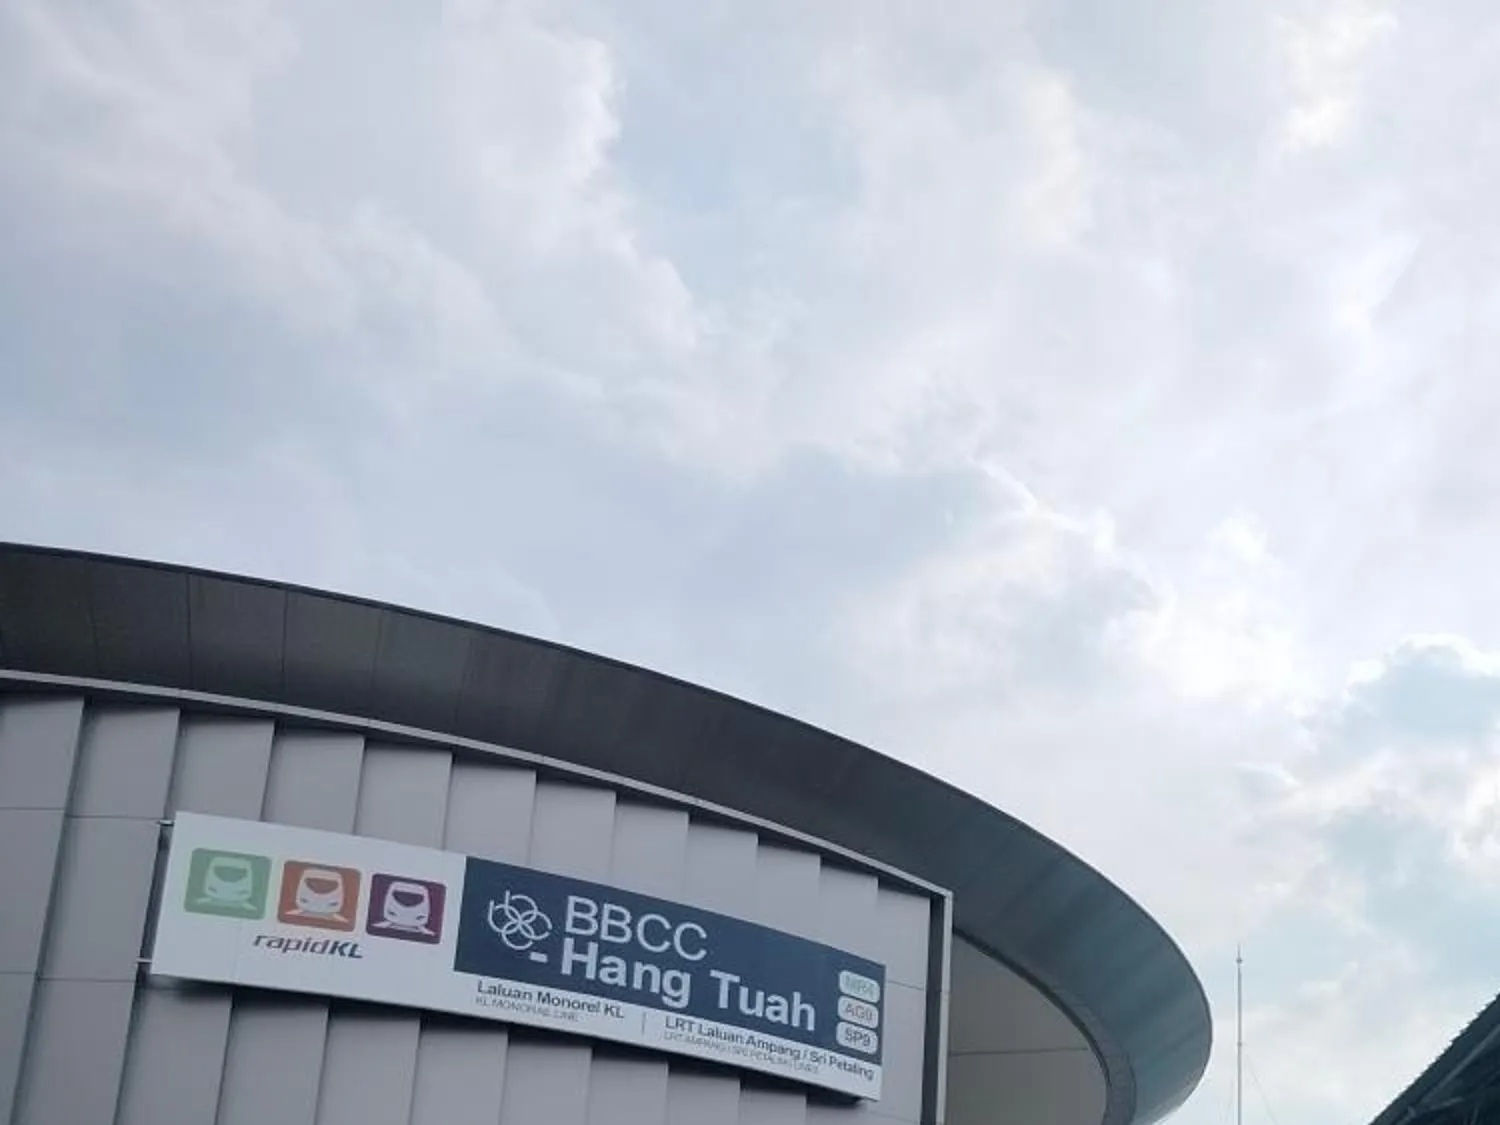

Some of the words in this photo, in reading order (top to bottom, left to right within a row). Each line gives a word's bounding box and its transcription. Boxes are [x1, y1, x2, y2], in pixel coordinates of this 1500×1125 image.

[252, 935, 363, 959] rapidKL
[564, 894, 708, 961] BBCC
[477, 979, 533, 1001] Laluan
[536, 990, 600, 1013] Monorel
[603, 1003, 625, 1019] KL
[560, 937, 692, 1009] Hang
[709, 968, 816, 1033] Tuah
[665, 1015, 695, 1033] LRT
[699, 1023, 744, 1045] Laluan
[745, 1035, 802, 1061] Ampang
